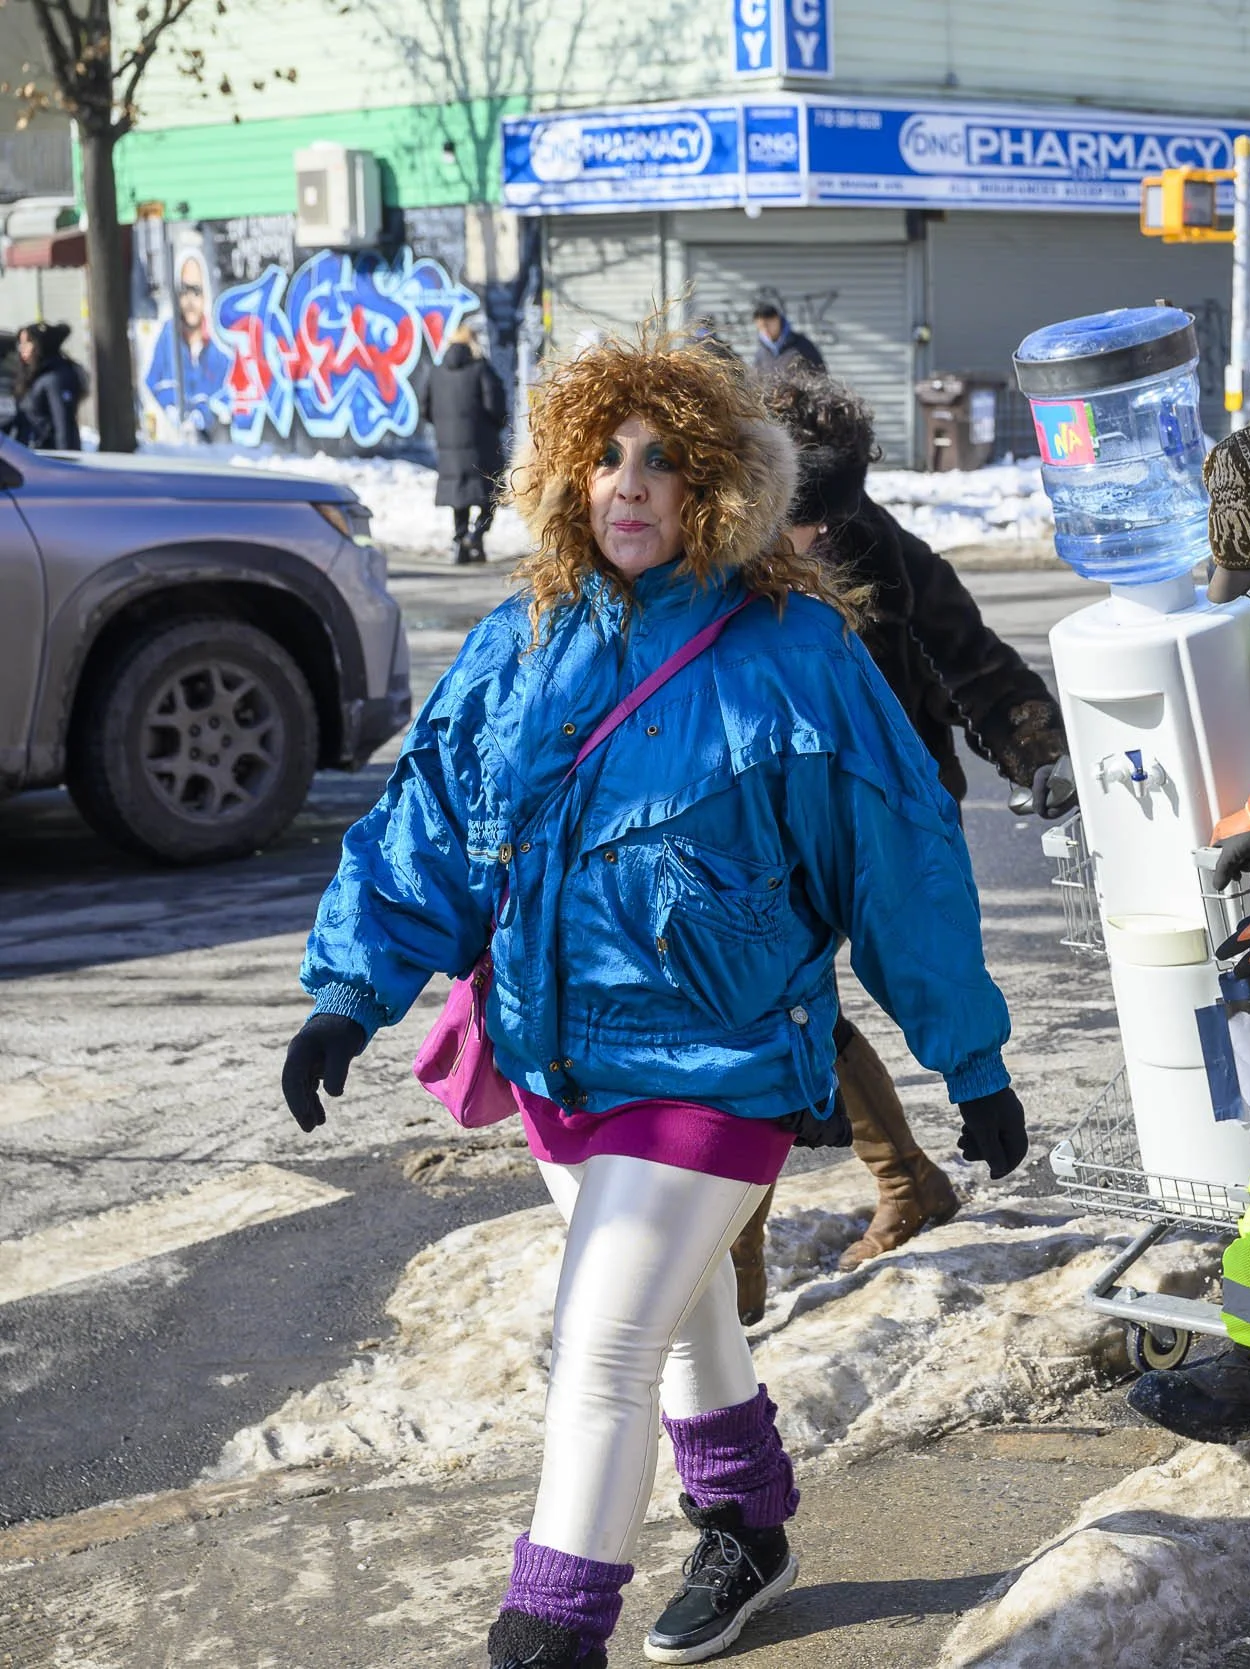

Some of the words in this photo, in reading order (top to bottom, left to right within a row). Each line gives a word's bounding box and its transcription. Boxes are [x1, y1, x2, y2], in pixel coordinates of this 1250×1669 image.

[583, 127, 701, 163] PHARMACY
[912, 131, 962, 157] DNG
[967, 127, 1223, 171] PHARMACY
